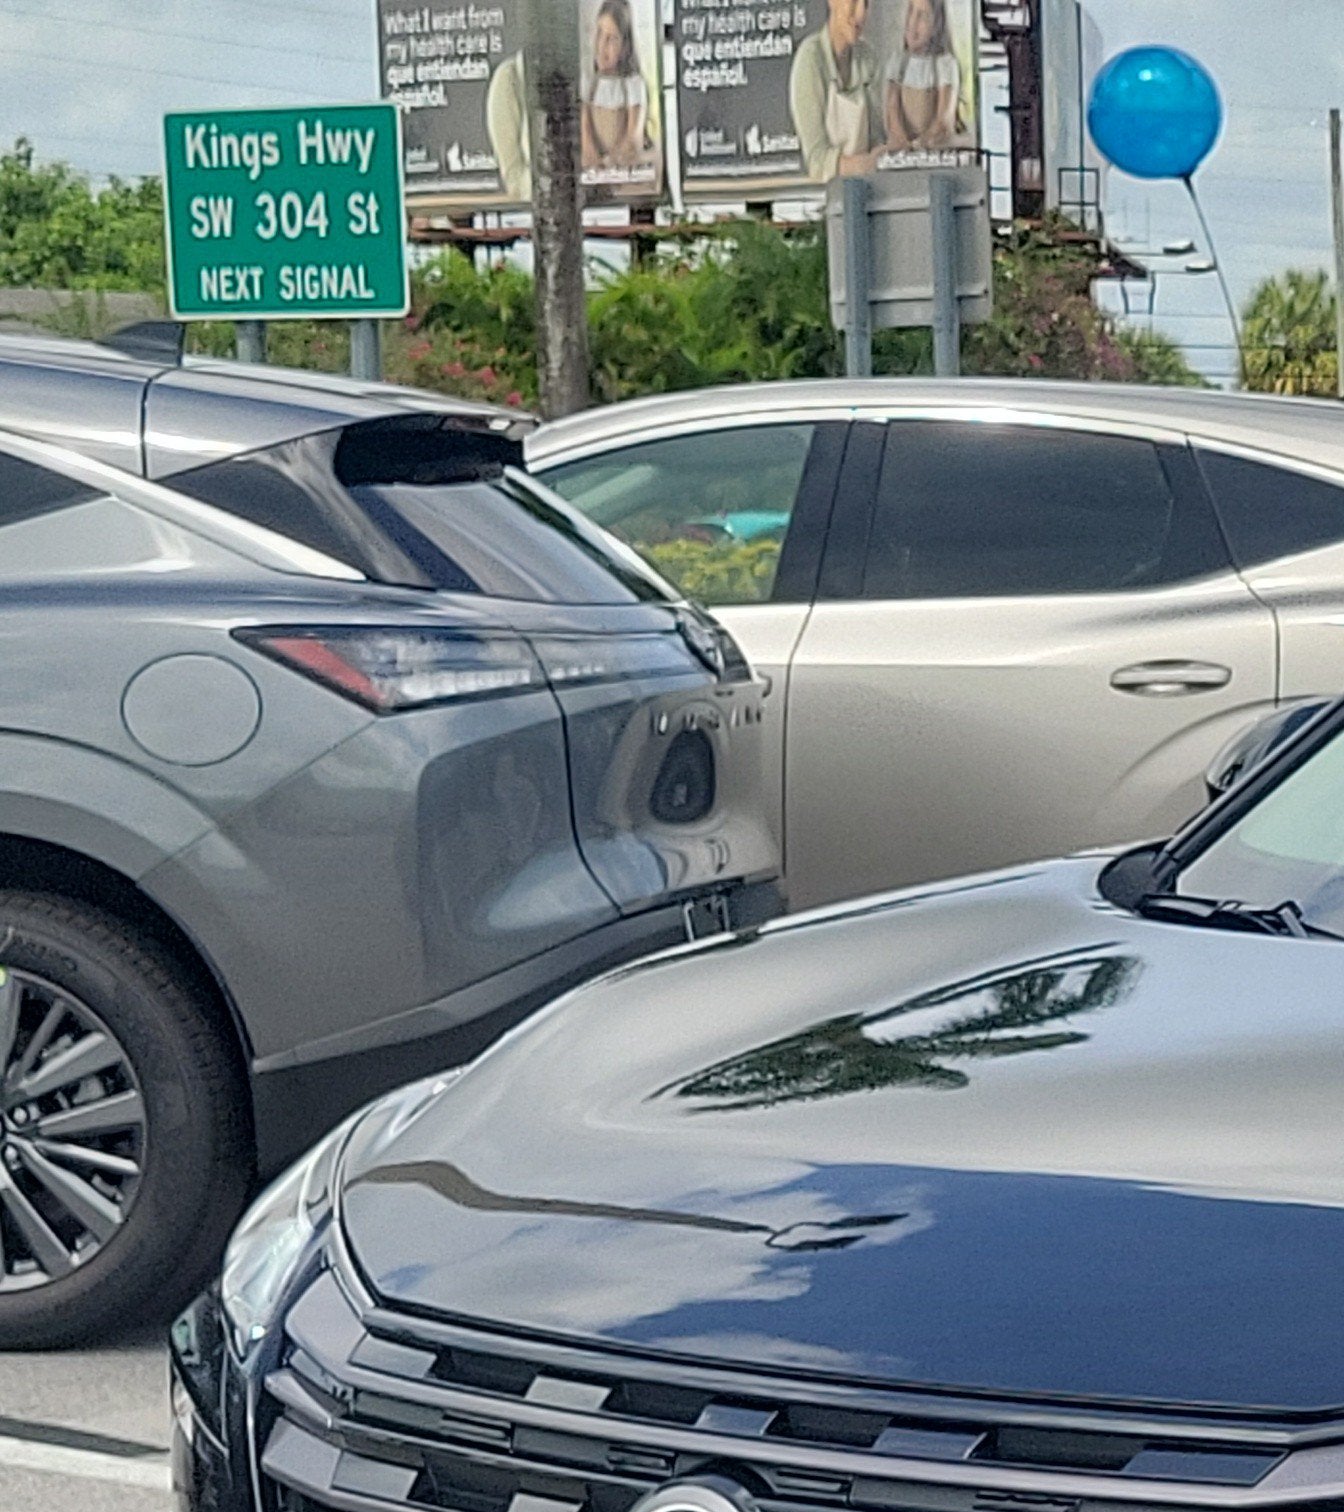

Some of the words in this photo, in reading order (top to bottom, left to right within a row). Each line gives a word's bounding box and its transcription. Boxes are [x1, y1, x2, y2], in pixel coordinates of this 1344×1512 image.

[184, 123, 280, 180] Kings
[297, 119, 375, 174] Hwy
[190, 196, 233, 238] SW
[255, 191, 328, 239] 304
[347, 191, 380, 235] St
[201, 265, 263, 301] NEXT
[279, 264, 376, 300] SIGNAL
